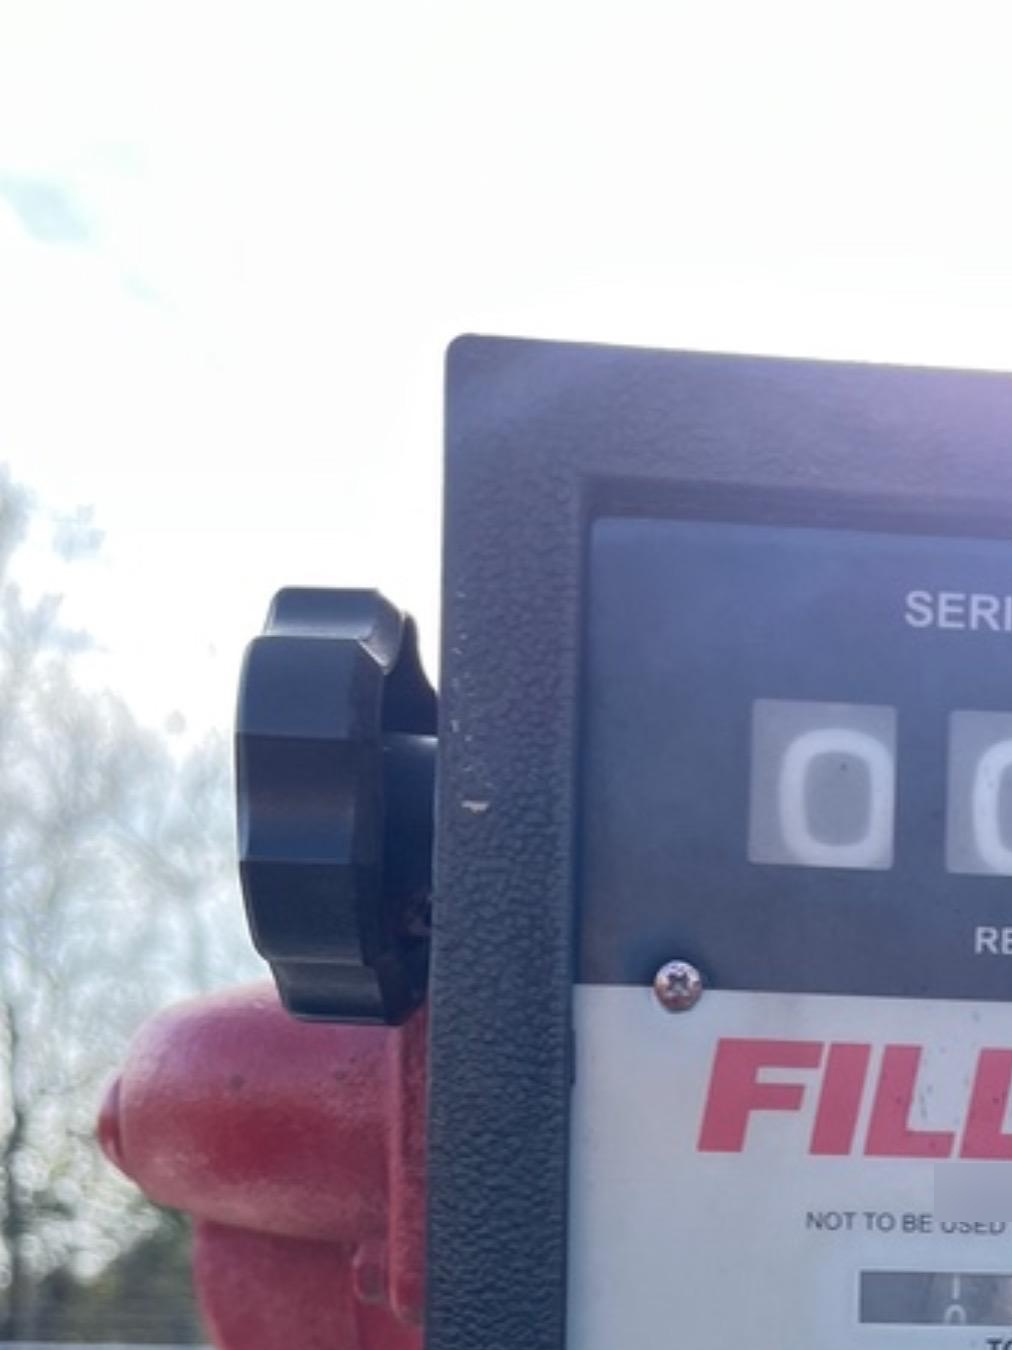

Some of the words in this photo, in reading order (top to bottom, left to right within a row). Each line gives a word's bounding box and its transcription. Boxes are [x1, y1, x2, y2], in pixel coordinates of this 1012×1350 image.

[805, 1210, 856, 1232] NOT
[863, 1212, 896, 1233] TO
[902, 1213, 934, 1234] BE
